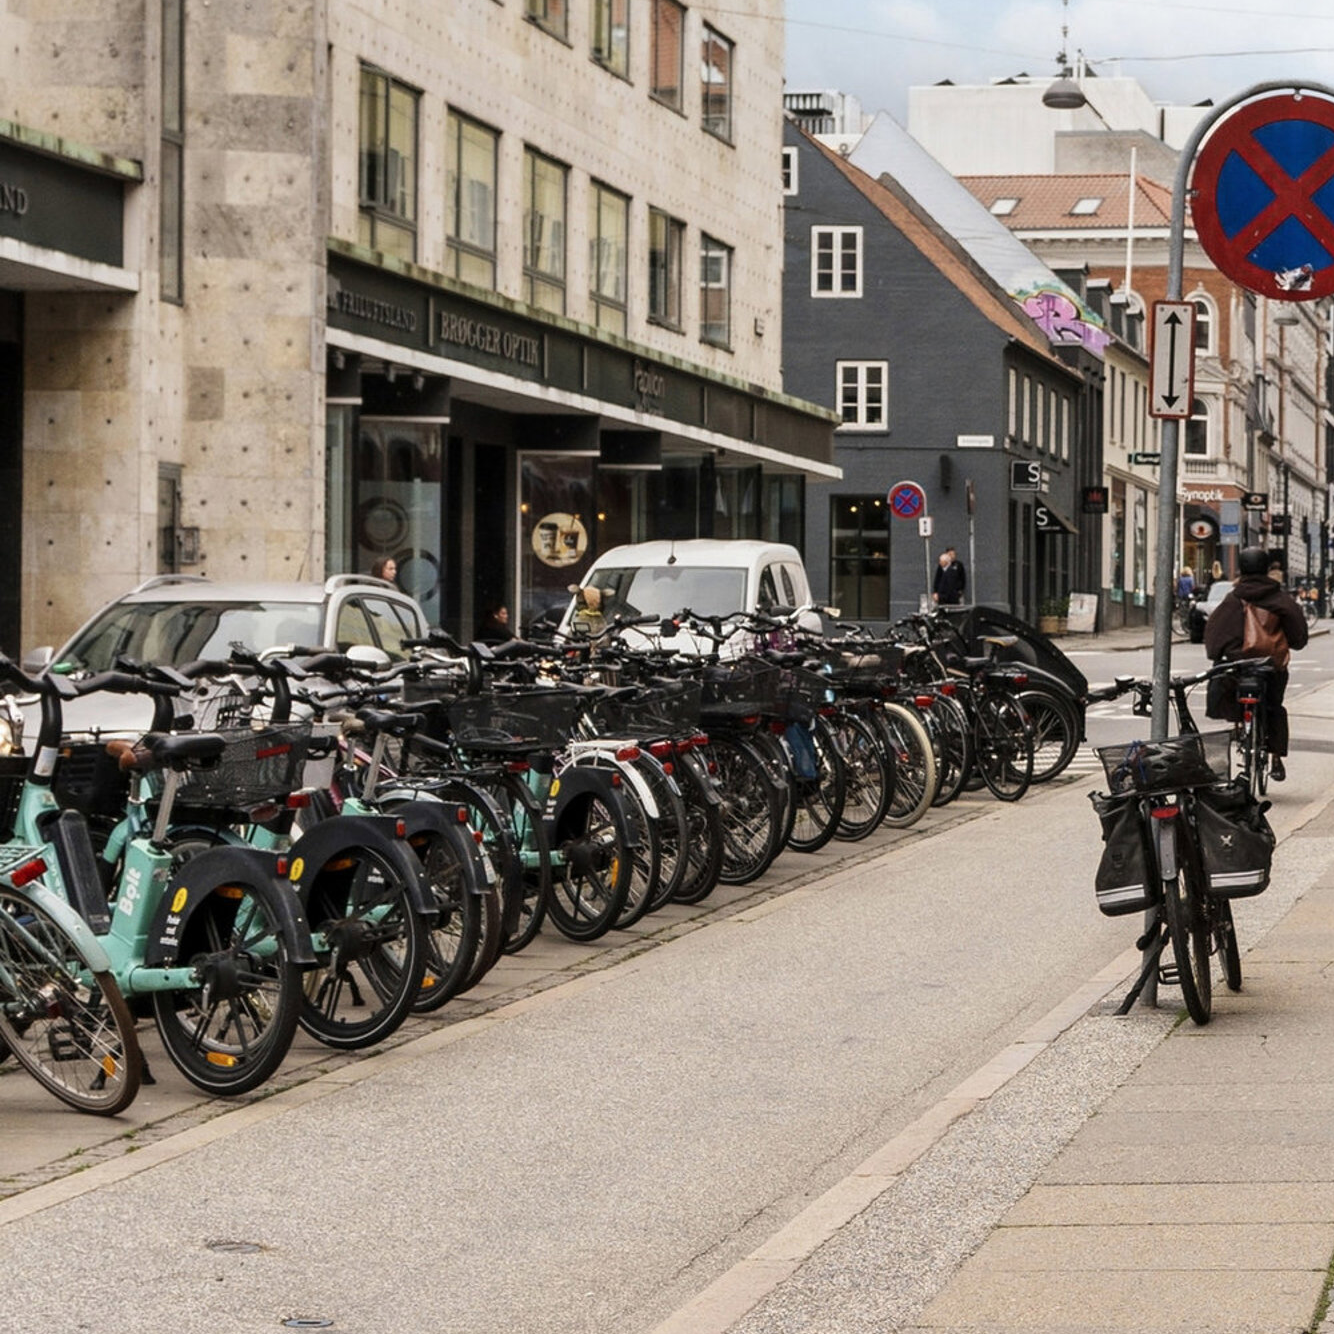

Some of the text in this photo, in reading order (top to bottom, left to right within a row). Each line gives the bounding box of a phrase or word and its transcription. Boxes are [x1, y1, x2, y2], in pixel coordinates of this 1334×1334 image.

[0, 181, 28, 215] ND
[440, 310, 539, 366] BRØGGER OPTIK
[1180, 487, 1225, 504] Synoptik
[119, 868, 142, 917] Bolt
